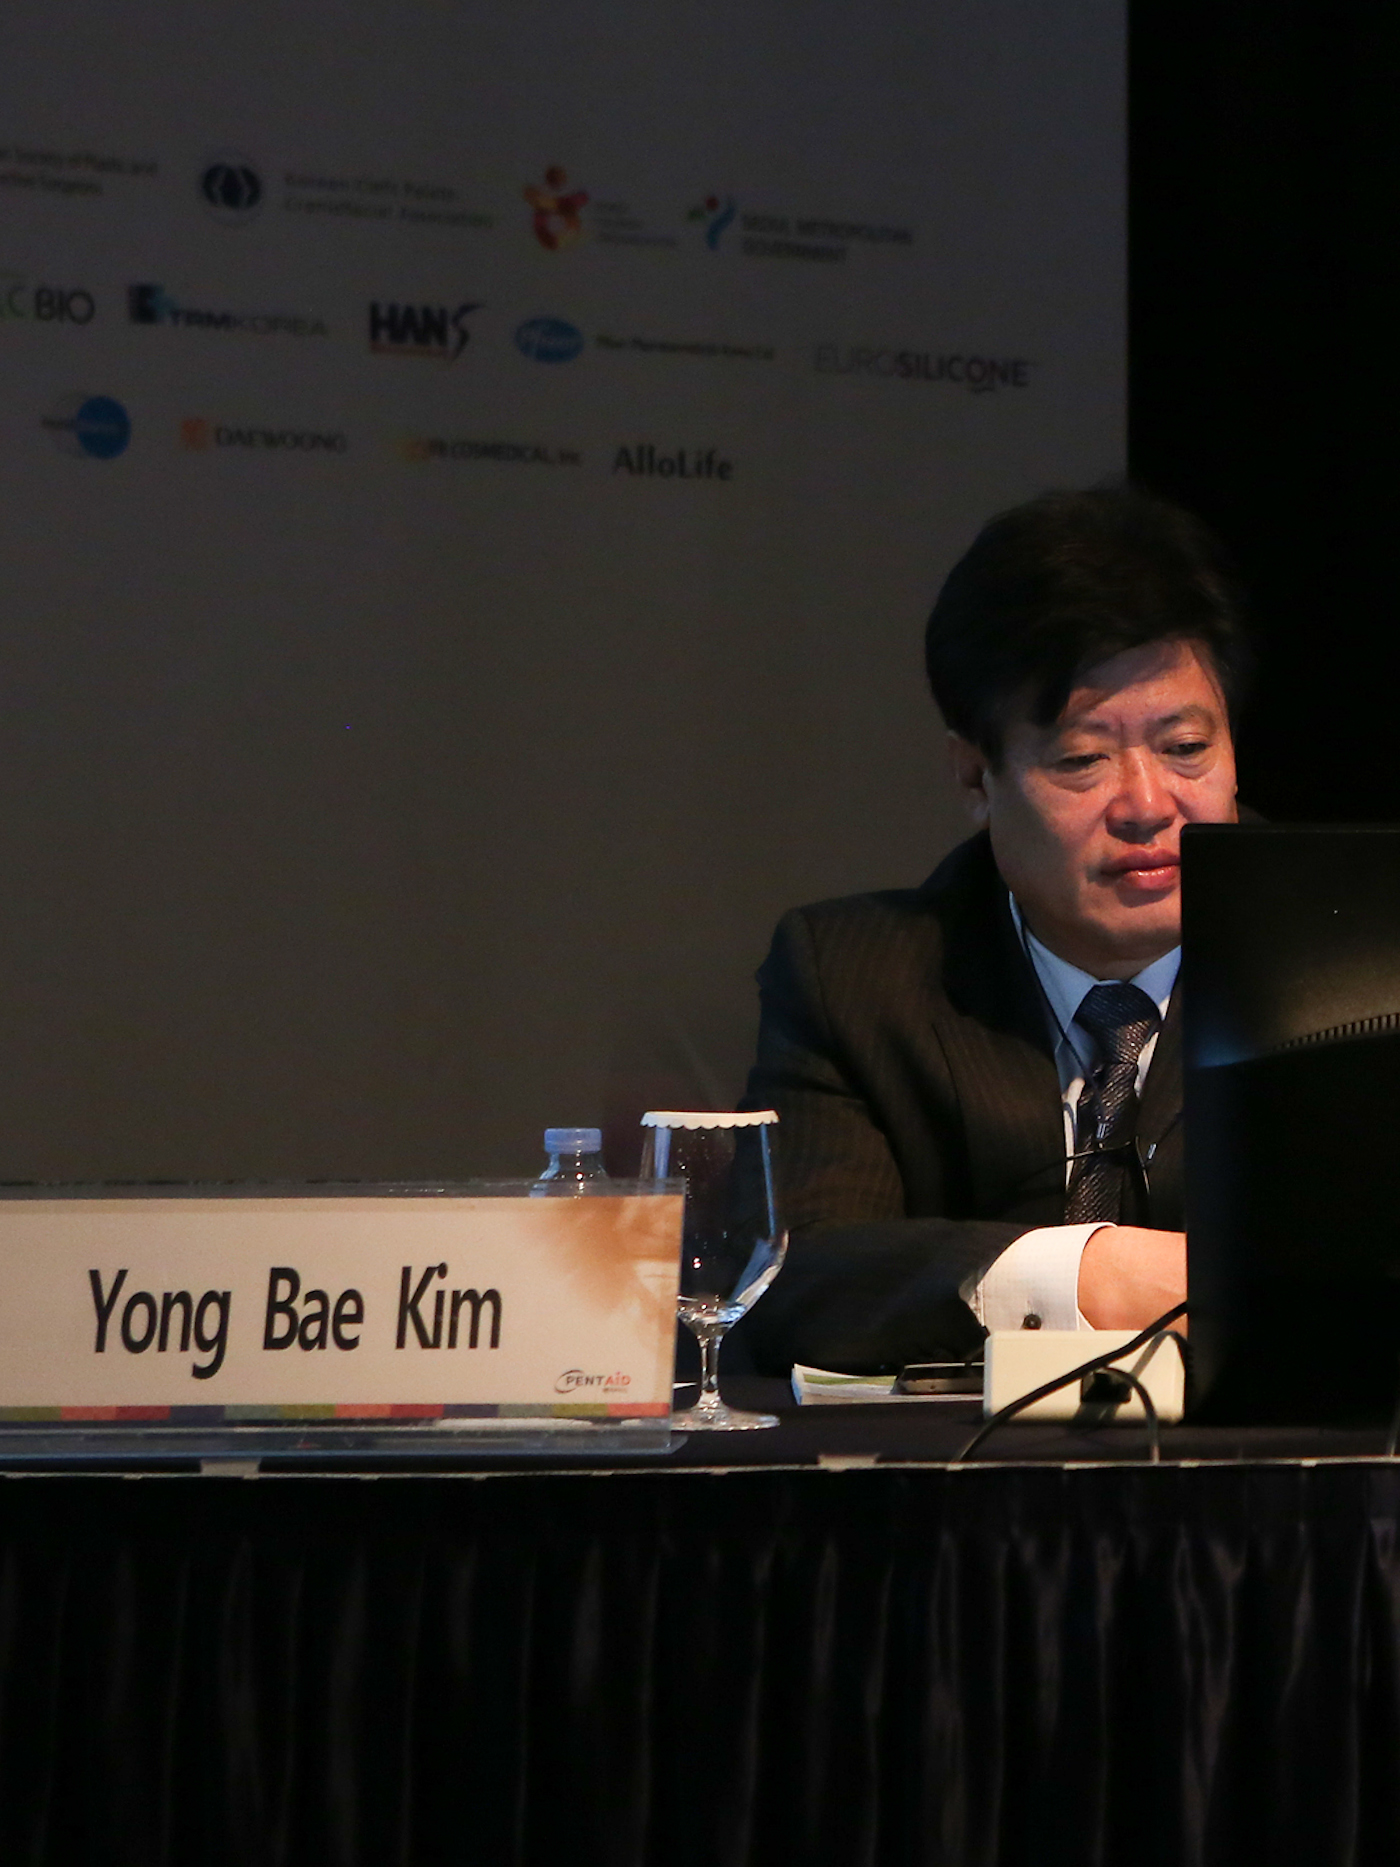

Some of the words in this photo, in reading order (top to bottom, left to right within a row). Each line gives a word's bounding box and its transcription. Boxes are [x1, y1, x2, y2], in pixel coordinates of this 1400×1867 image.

[814, 343, 1030, 390] EUROSILICONE
[612, 443, 734, 480] AlloLife
[88, 1268, 231, 1381] Yong
[263, 1266, 365, 1352] Bae
[396, 1262, 503, 1350] Kim
